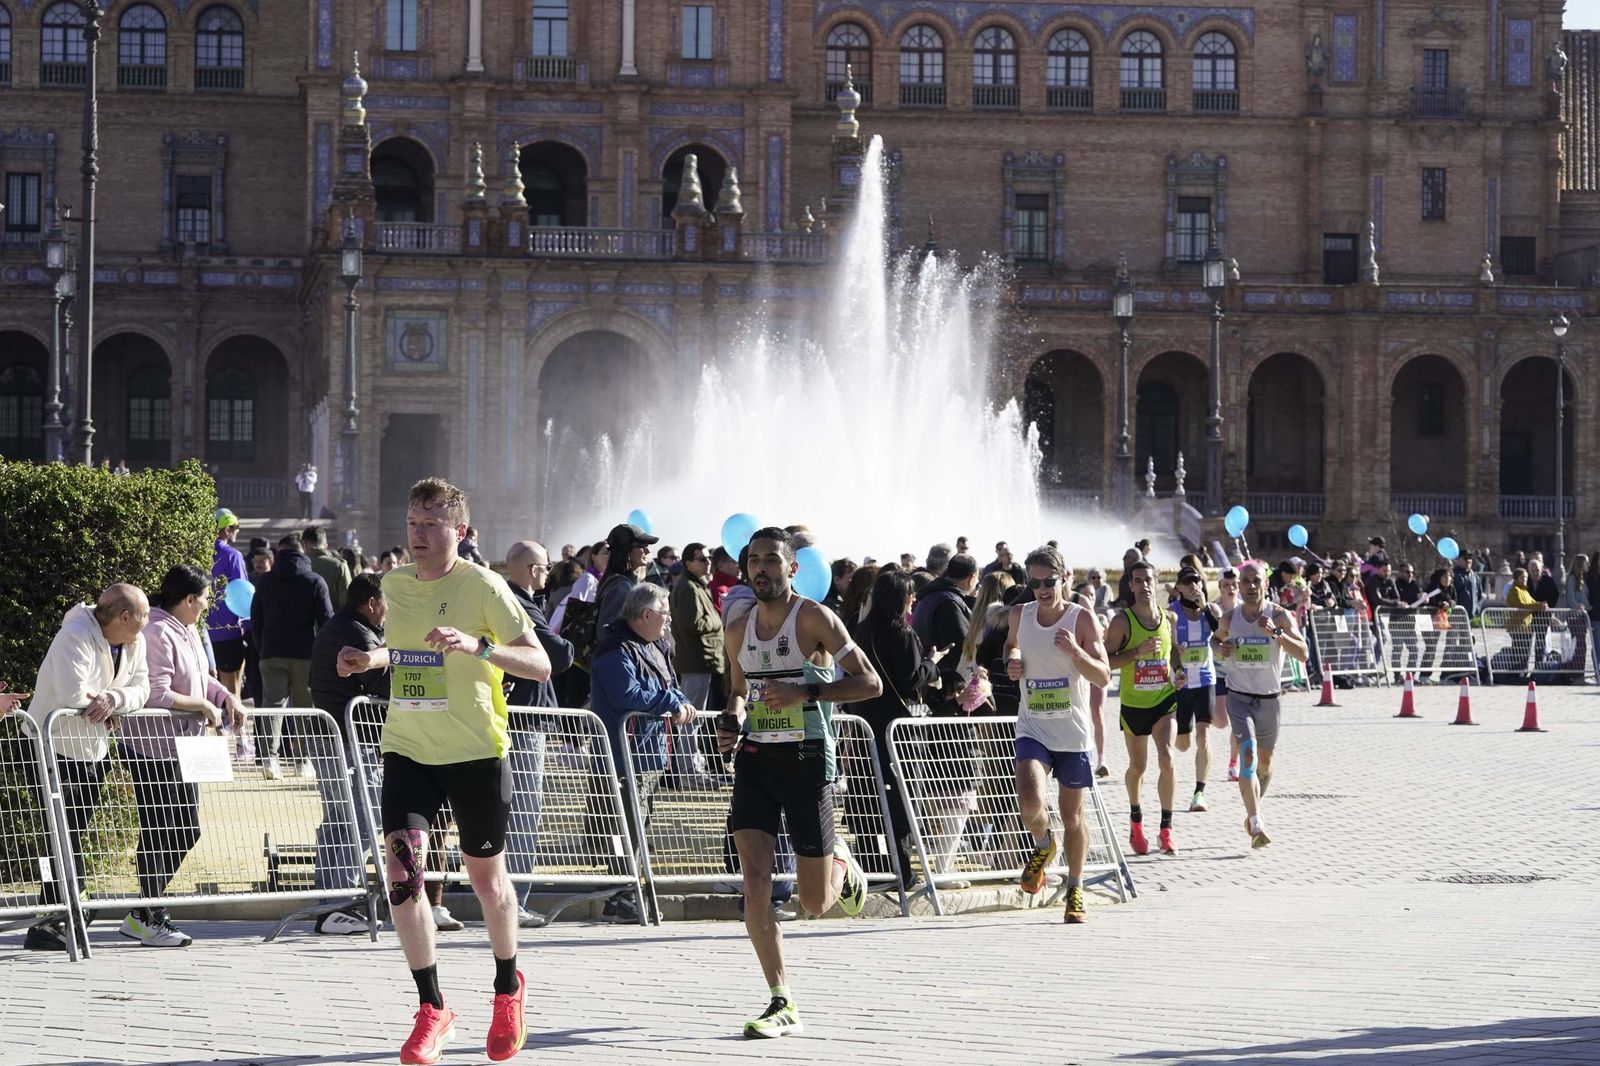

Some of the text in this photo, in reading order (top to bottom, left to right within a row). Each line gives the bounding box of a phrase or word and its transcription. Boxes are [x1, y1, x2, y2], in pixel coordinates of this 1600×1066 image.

[403, 655, 436, 663] ZURICH
[404, 672, 422, 681] 1707
[403, 684, 425, 697] FOD
[1028, 701, 1072, 711] JOHN DENNIS
[757, 717, 795, 730] MIGUEL
